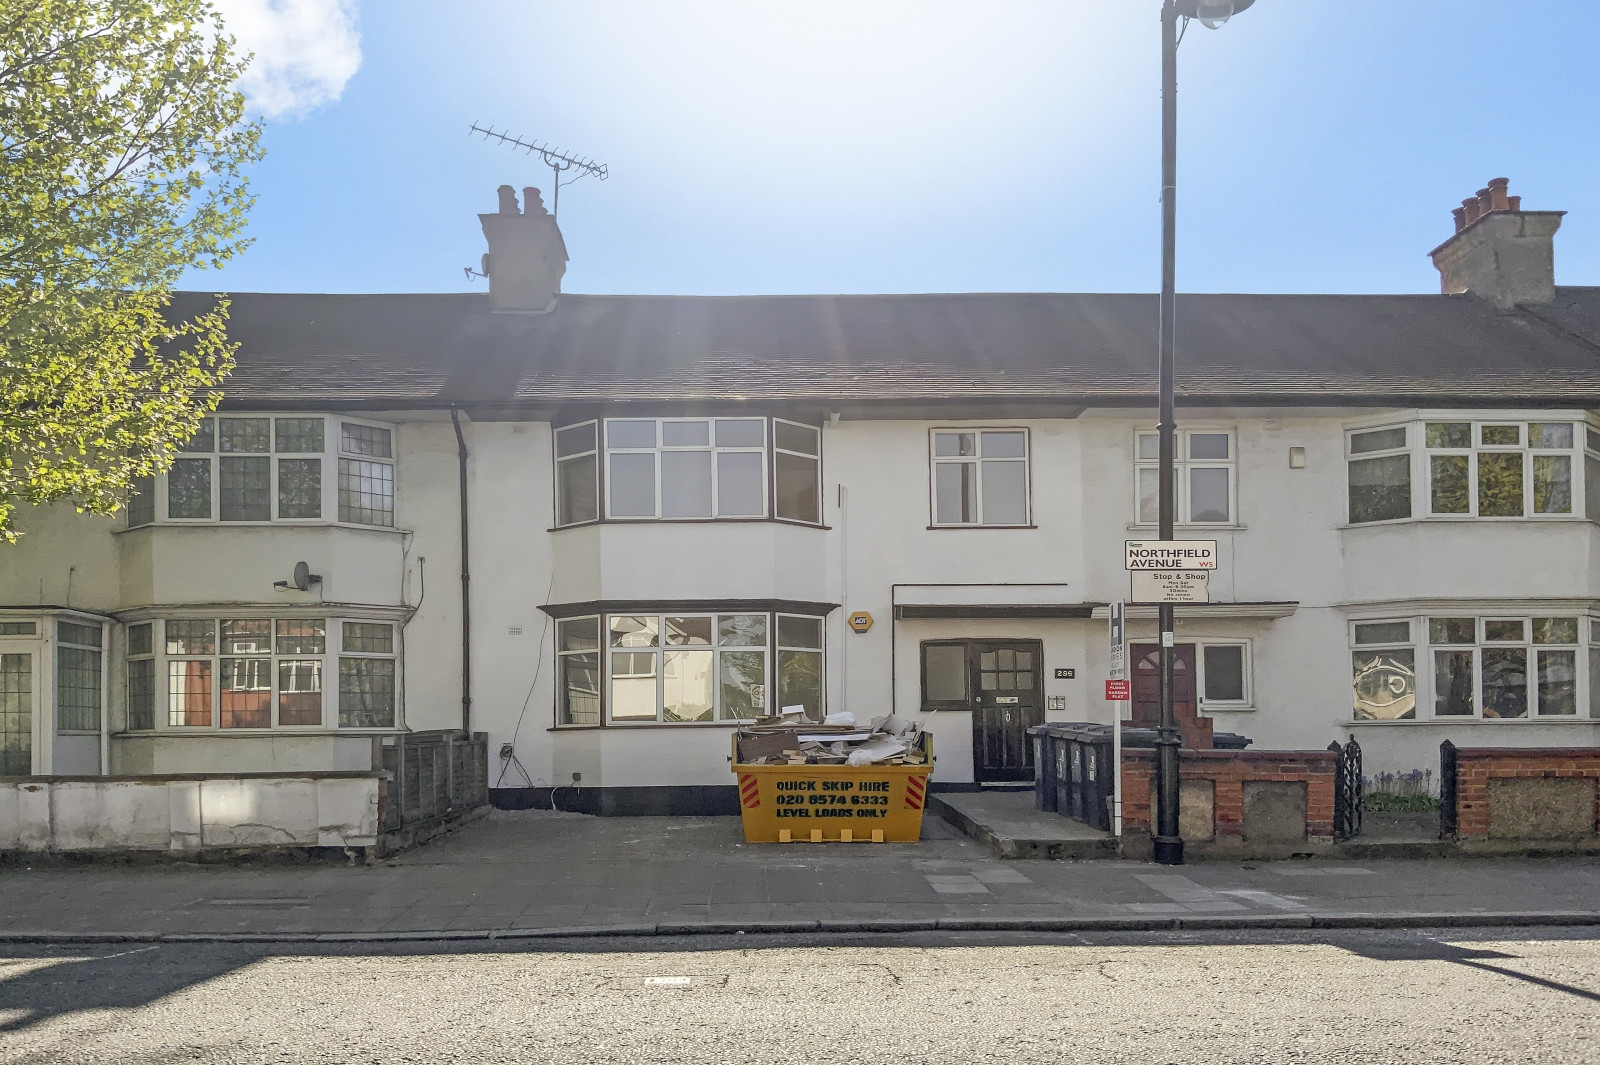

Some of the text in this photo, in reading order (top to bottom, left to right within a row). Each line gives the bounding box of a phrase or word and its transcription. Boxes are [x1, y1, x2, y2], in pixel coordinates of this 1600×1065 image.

[1129, 549, 1211, 558] NORTHFIELD
[1130, 559, 1182, 568] AVENUE
[1153, 573, 1173, 581] Stop
[1185, 573, 1206, 581] Shop
[776, 781, 890, 792] QUICK SKIP HIRE
[776, 795, 888, 805] 020 8574 6333
[776, 808, 888, 818] LEVEL LOADS ONLY
